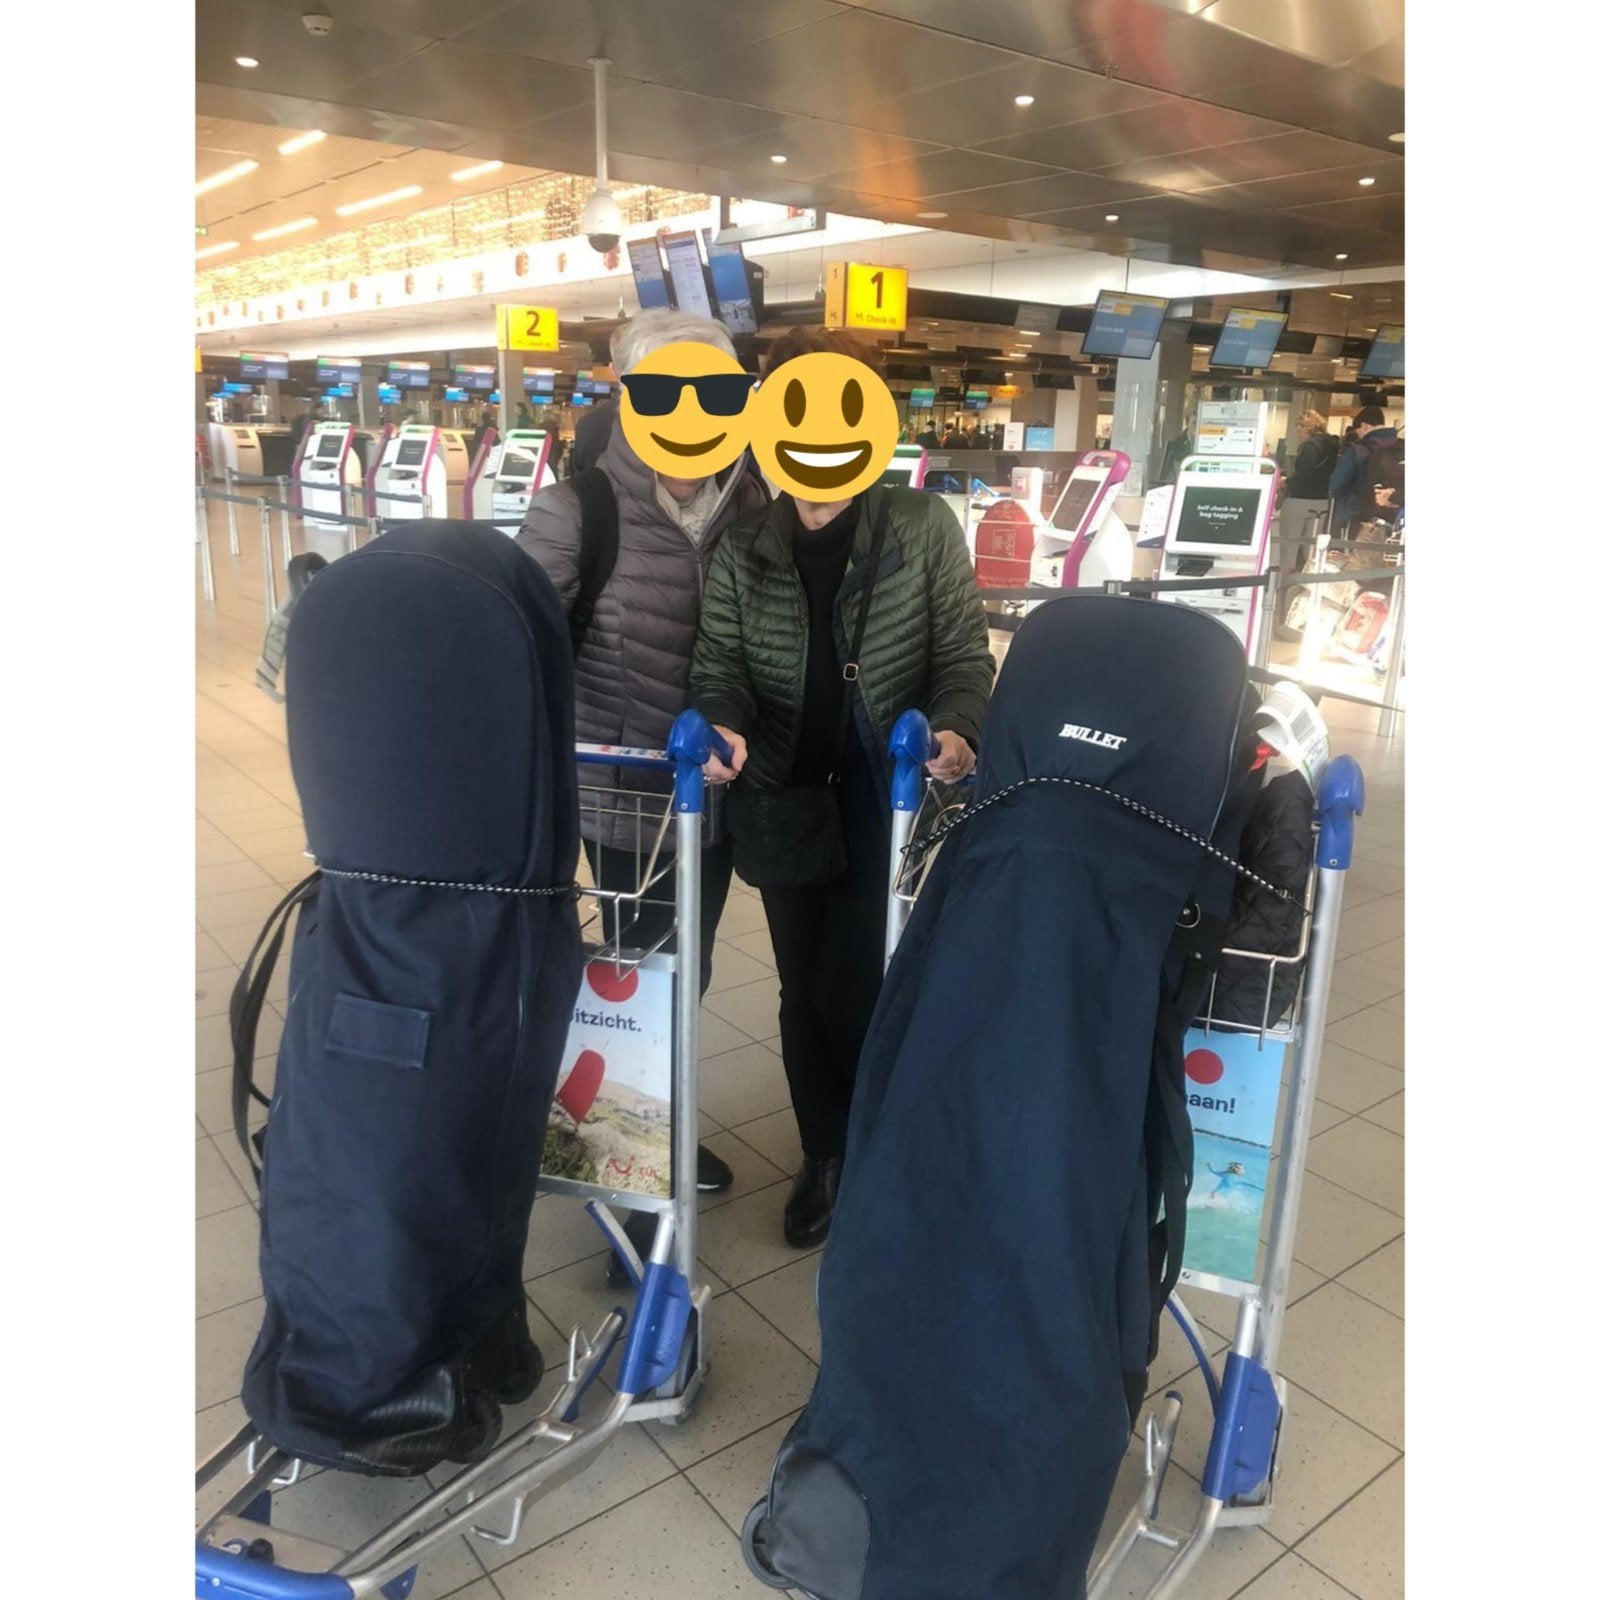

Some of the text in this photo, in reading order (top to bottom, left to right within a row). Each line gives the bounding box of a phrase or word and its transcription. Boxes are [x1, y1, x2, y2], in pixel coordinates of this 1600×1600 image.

[870, 270, 885, 309] 1
[525, 310, 542, 337] 2
[866, 314, 897, 325] Check-in
[1197, 504, 1210, 512] Self
[1211, 505, 1237, 513] check-in
[1199, 510, 1239, 520] bag tagging
[1058, 722, 1128, 750] BULLET
[574, 1007, 642, 1032] itzicht.
[1186, 1093, 1236, 1114] aan!
